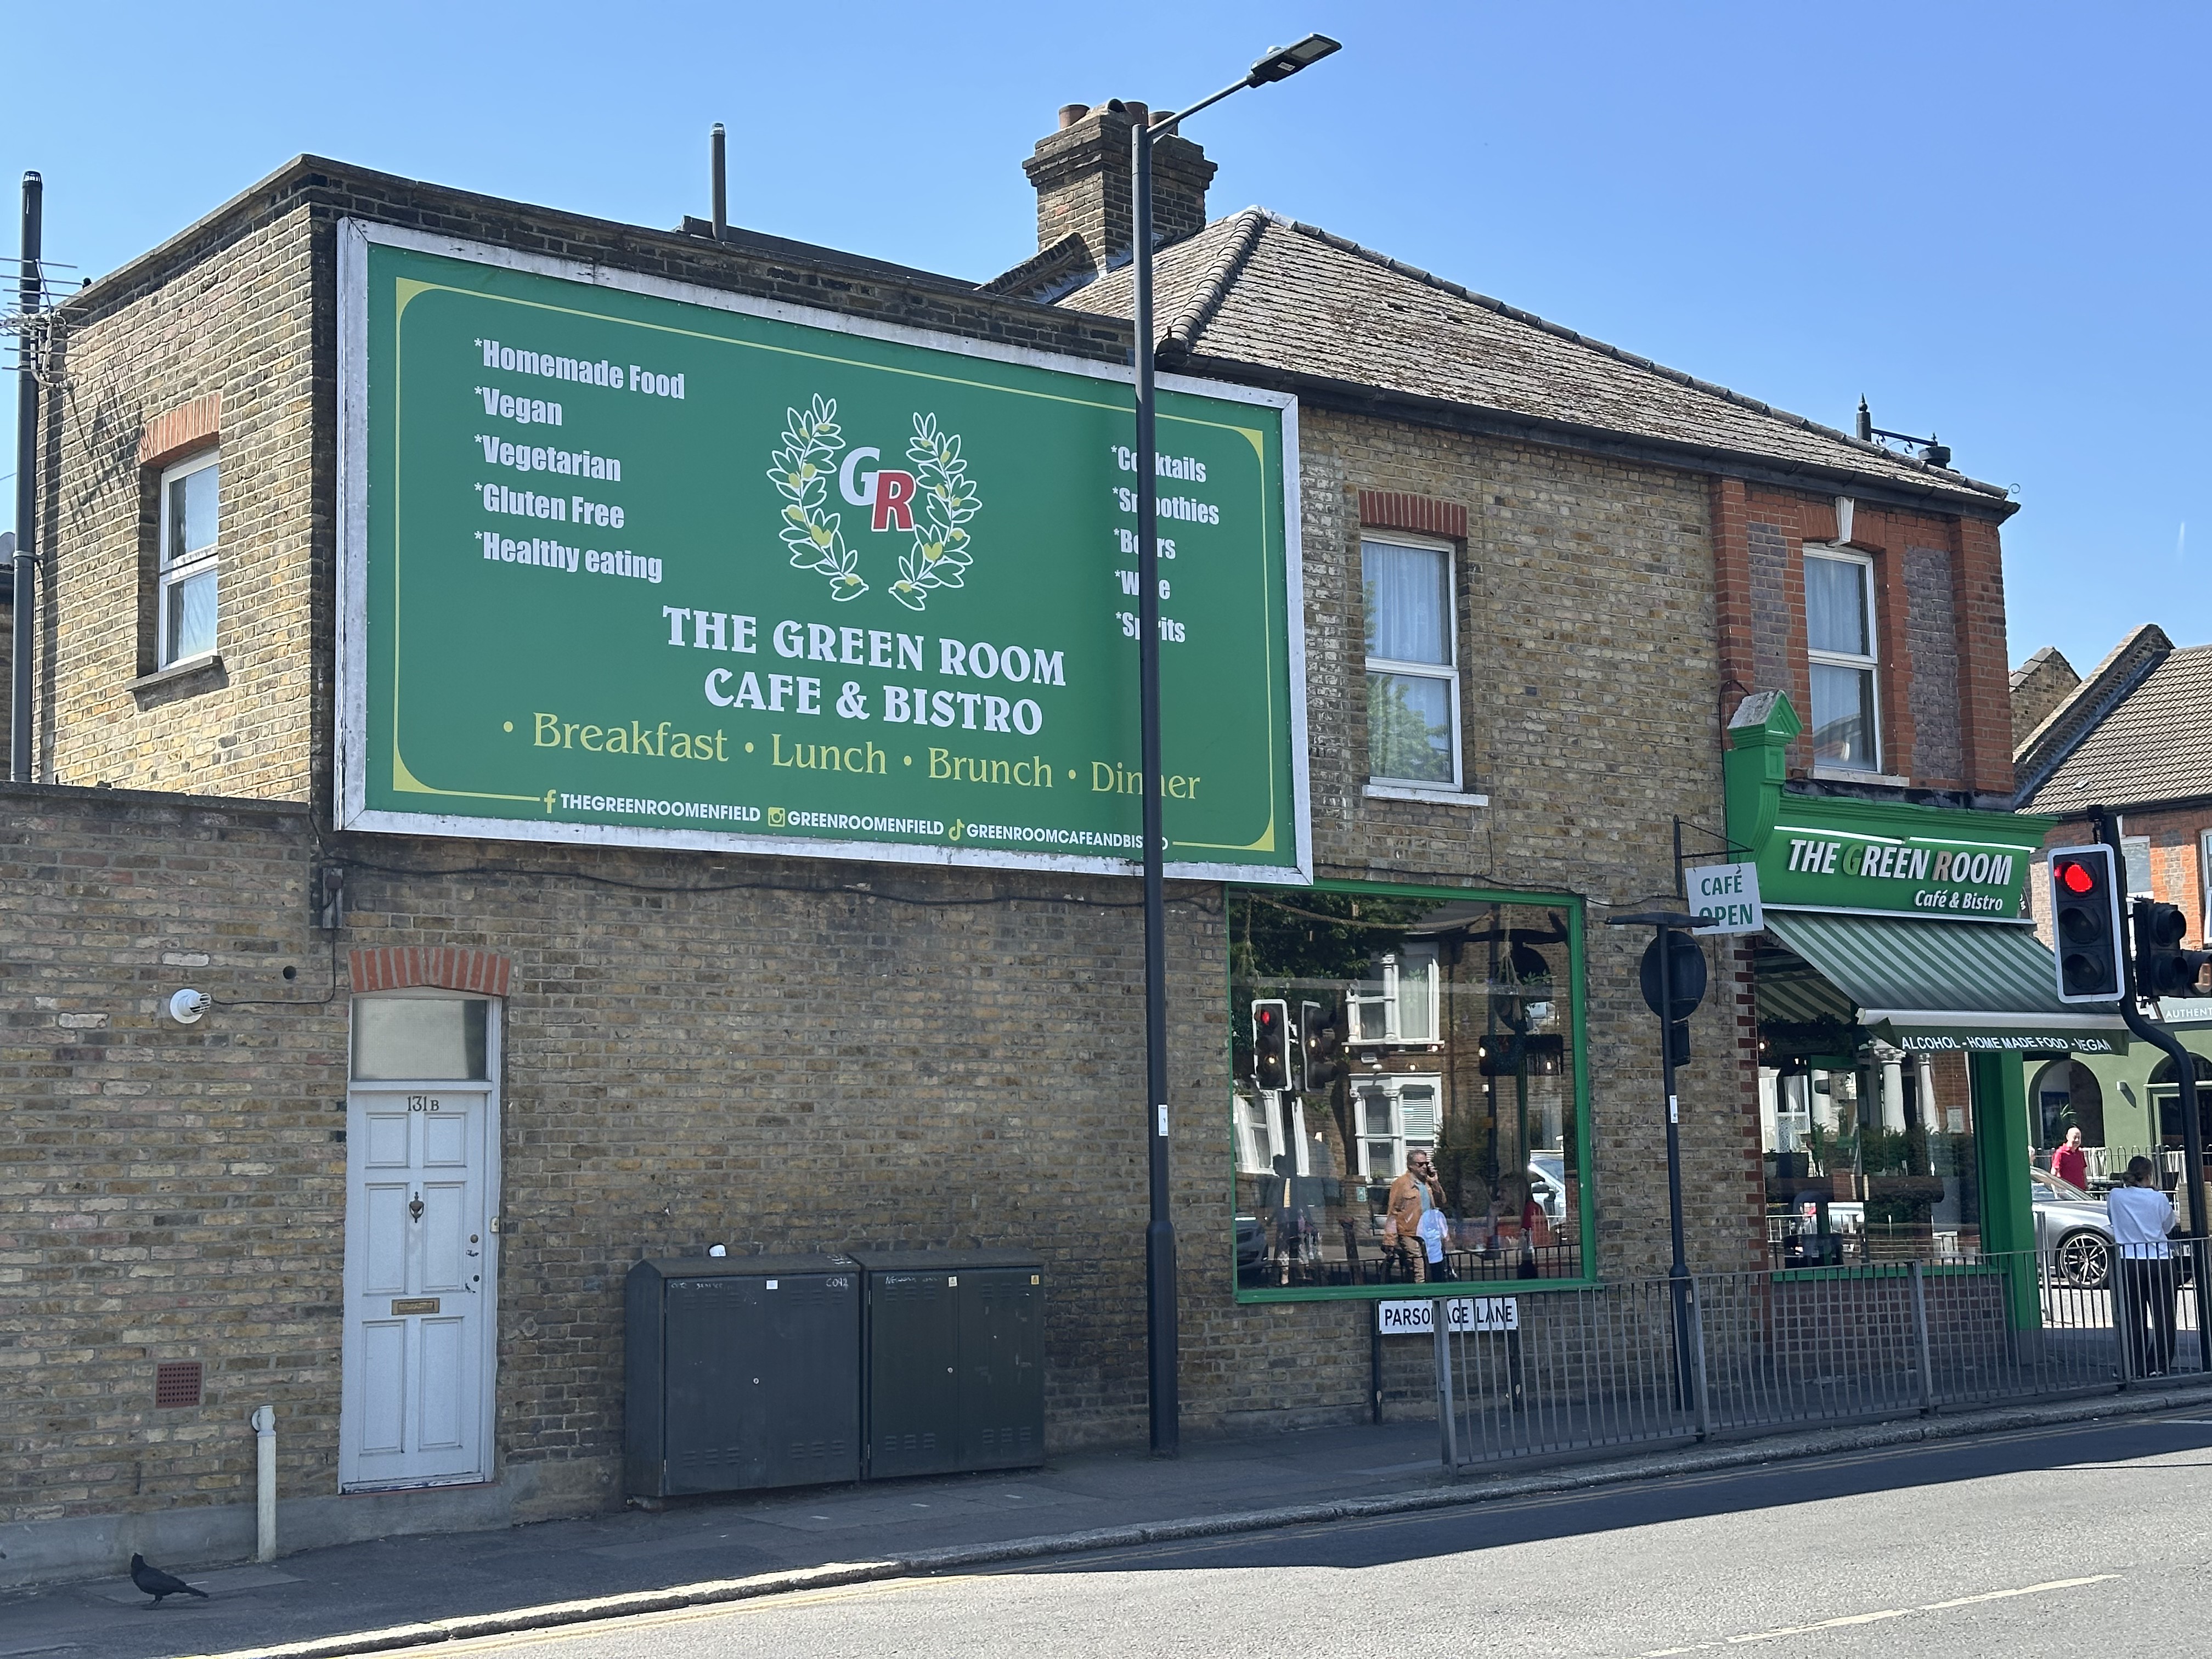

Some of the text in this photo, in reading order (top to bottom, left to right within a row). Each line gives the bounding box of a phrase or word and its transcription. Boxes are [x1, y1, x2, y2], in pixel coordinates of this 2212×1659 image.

[629, 364, 685, 399] Food
[572, 495, 624, 529] Free
[585, 550, 662, 584] eating
[662, 605, 1066, 686] THE GREEN ROOM
[704, 668, 1042, 735] CAFE & BISTRO
[533, 712, 729, 762] Breakfast
[771, 733, 887, 775] Lunch
[928, 747, 1053, 788] Brunch
[560, 793, 761, 822] THEGREENROOMENFIELD
[788, 811, 944, 836] GREENROOMENFIELD
[966, 823, 1169, 850] GREENROOMCAFEANDBISO
[1789, 839, 2013, 885] THE GREEN ROOM
[1701, 869, 1743, 896] CAFÉ
[1915, 889, 1948, 908] Café
[1949, 891, 1960, 909] &
[1962, 893, 2003, 911] Bistro
[1901, 1036, 2112, 1051] ALCOHOL HOME MADE FOOD VEGAN
[1385, 1305, 1513, 1326] PARSOGE LANE
